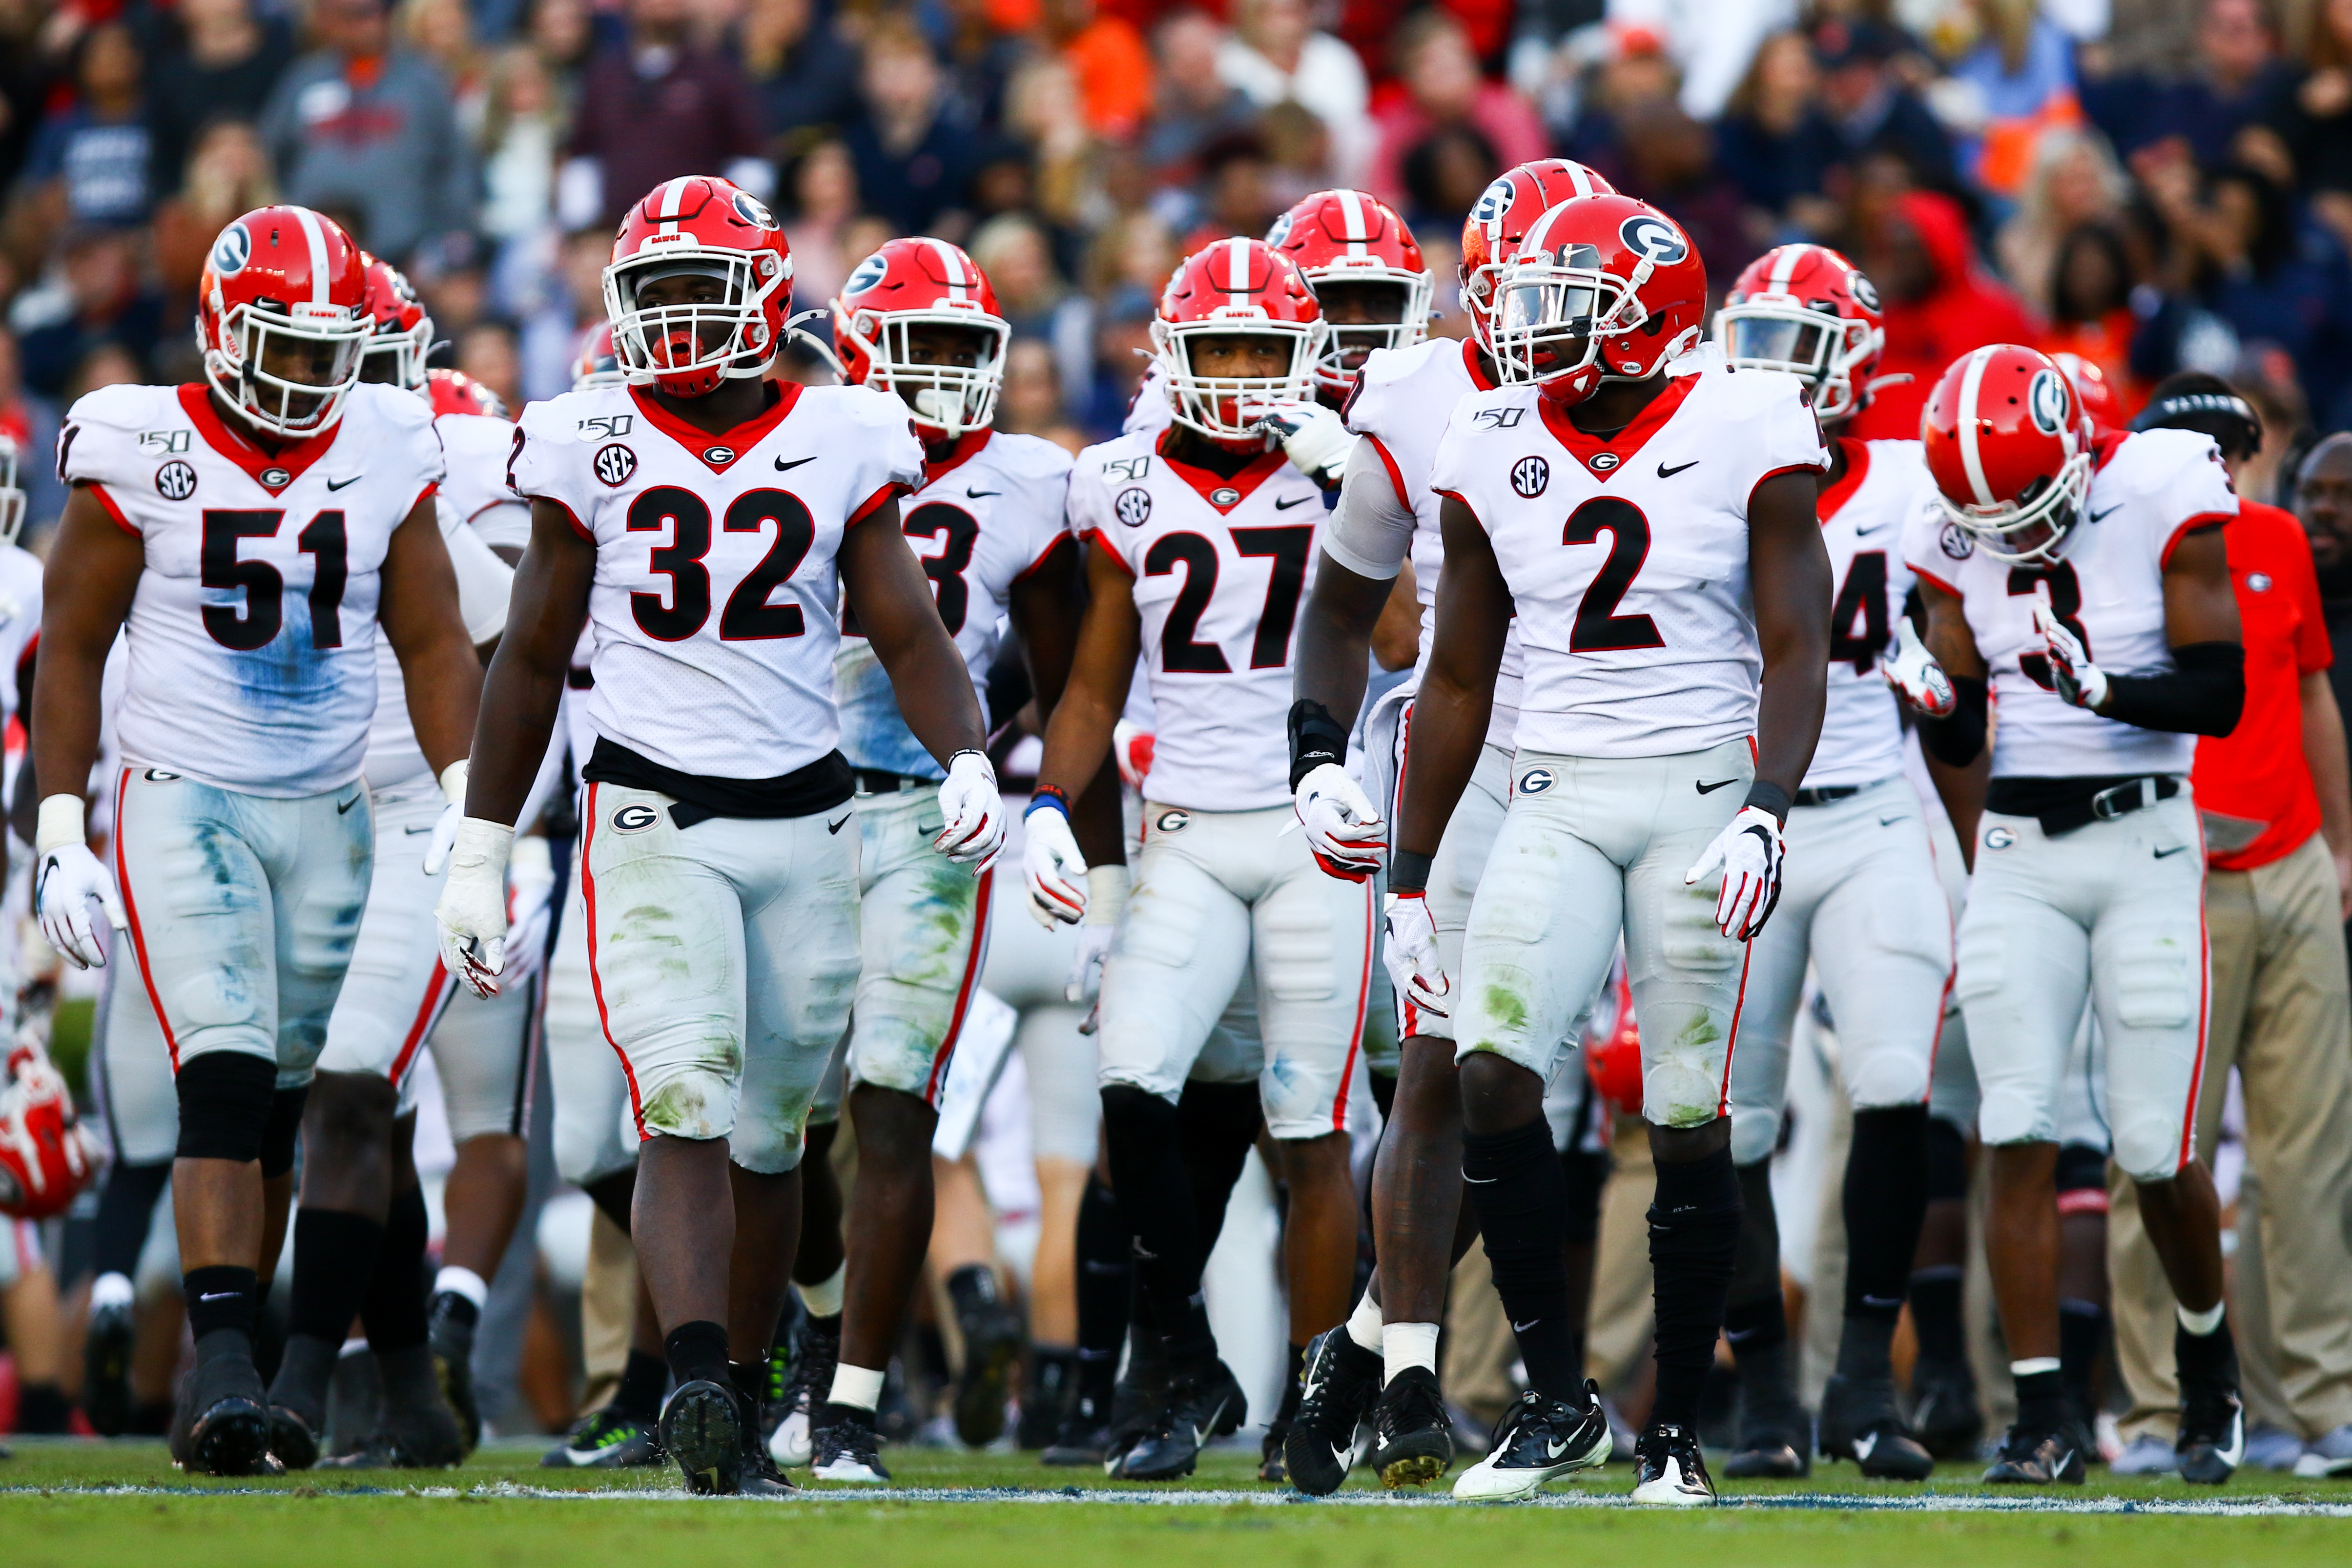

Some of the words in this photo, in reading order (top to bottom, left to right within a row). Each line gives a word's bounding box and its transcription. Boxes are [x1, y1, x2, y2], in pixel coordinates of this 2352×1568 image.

[733, 191, 780, 229] G
[213, 223, 250, 273] G
[651, 234, 681, 244] DAWGS
[1620, 216, 1687, 265] G
[845, 255, 887, 295] G
[577, 415, 633, 440] 150
[1472, 407, 1526, 431] 150
[137, 430, 191, 456] 150
[704, 447, 734, 463] G
[261, 469, 289, 486] G
[598, 446, 634, 484] SEC
[1102, 455, 1150, 484] 150
[1513, 457, 1547, 495] SEC
[1590, 454, 1619, 470] G
[158, 462, 195, 498] SEC
[1117, 489, 1150, 525] SEC
[1212, 489, 1239, 505] G
[201, 509, 348, 650] 51
[627, 485, 815, 642] 32
[1563, 495, 1666, 654] 2
[1145, 524, 1315, 673] 27
[2006, 553, 2093, 691] 3
[1519, 768, 1556, 796] G
[612, 803, 660, 833] G
[1156, 809, 1190, 832] G
[1985, 825, 2017, 851] G
